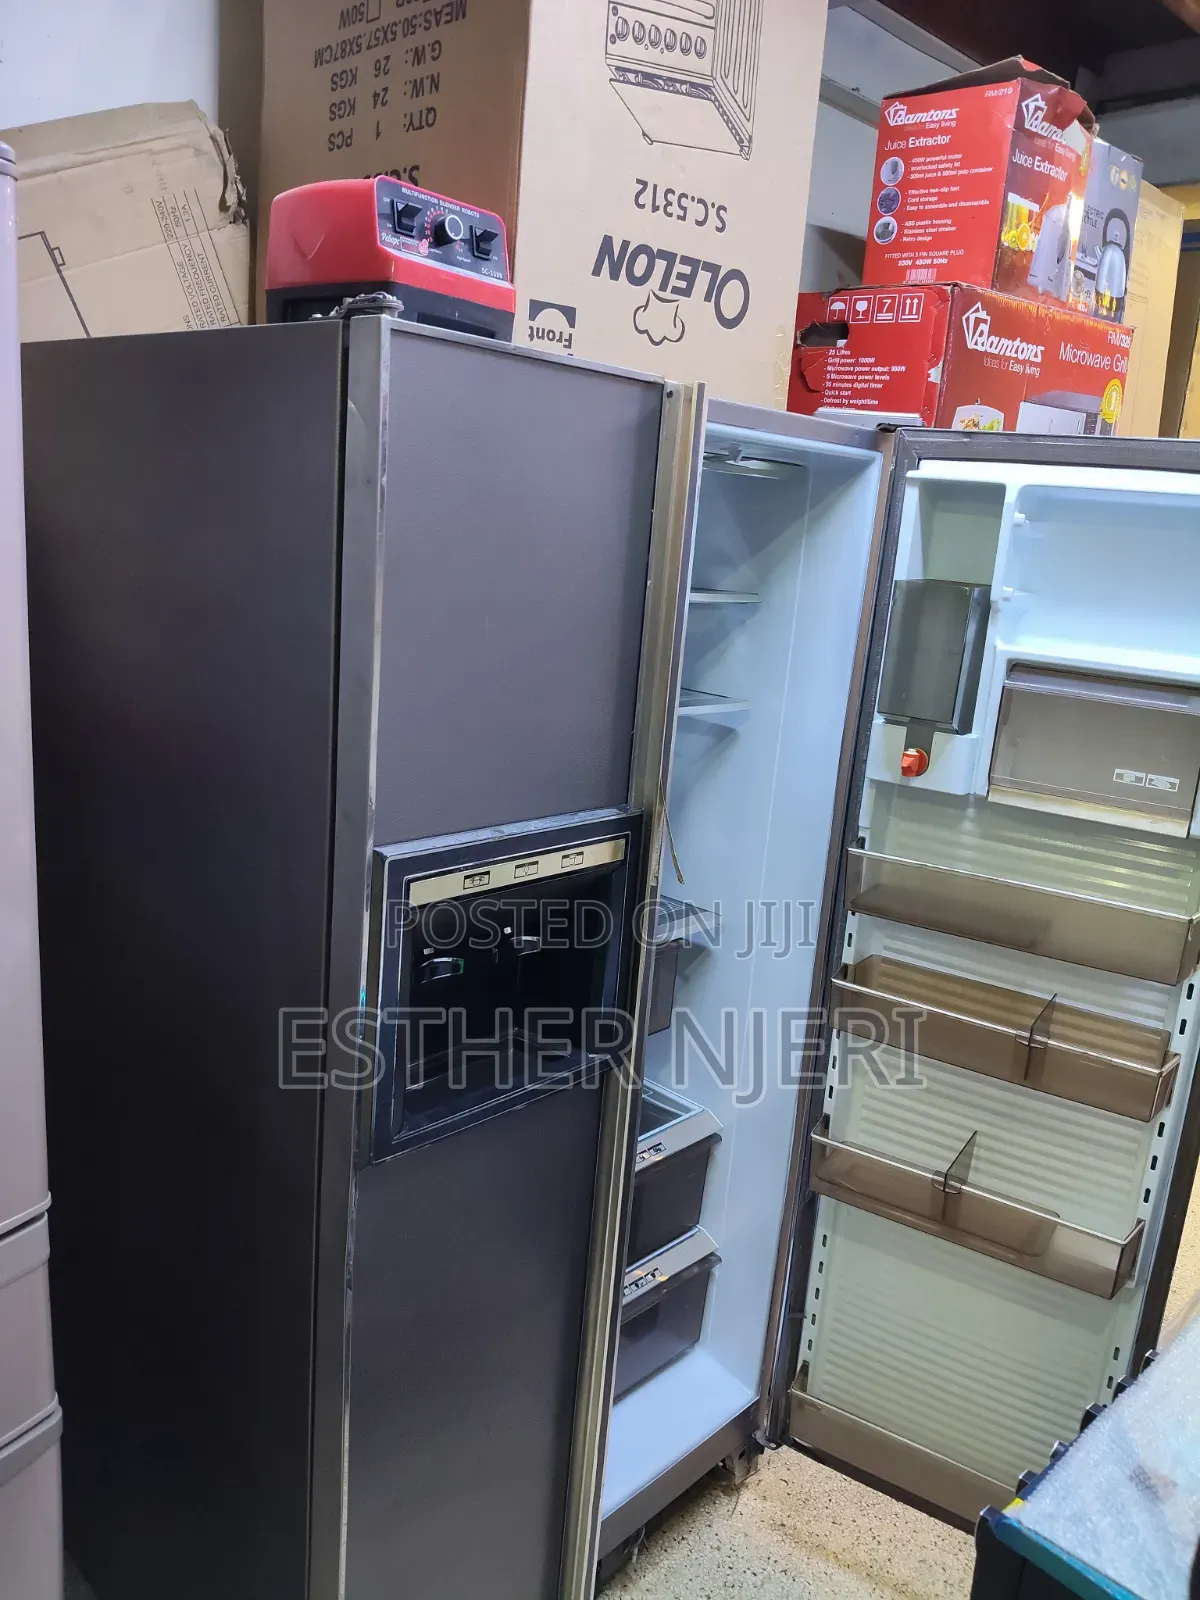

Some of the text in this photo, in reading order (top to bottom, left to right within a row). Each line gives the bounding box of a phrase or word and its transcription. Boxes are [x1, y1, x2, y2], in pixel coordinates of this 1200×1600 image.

[338, 2, 365, 30] 50W
[330, 65, 358, 92] KGS
[374, 55, 391, 78] 26
[329, 97, 356, 121] KGS
[372, 86, 389, 109] 24
[888, 105, 960, 126] Ramtons
[925, 122, 940, 130] Easy
[941, 121, 957, 129] living
[328, 106, 437, 151] QTY: 1 PCS
[885, 134, 952, 151] Juice Extractor
[925, 155, 947, 164] powerful
[1012, 149, 1068, 182] Juice Extractor
[401, 187, 439, 204] MULTIFUNCTION
[439, 200, 461, 212] BLENDER
[633, 178, 728, 233] S.C.5312
[920, 195, 938, 203] storage
[932, 218, 952, 226] housing
[916, 235, 933, 243] design
[884, 252, 902, 260] FITTED
[928, 249, 950, 257] SQUARE
[950, 248, 965, 256] PLUG
[176, 260, 196, 301] VOLTAGE
[182, 243, 205, 297] FREQUENCY
[591, 234, 750, 330] OLELON
[196, 252, 226, 323] RATED CURRENT
[192, 301, 205, 329] RATED
[201, 297, 215, 326] RATED
[882, 299, 892, 313] 7
[528, 325, 573, 349] Front
[969, 318, 1045, 364] Ramtons
[983, 356, 1000, 369] Ideas
[1008, 360, 1025, 375] Easy
[1025, 362, 1041, 378] living
[1059, 341, 1112, 370] Microwave
[830, 373, 857, 381] Microwave
[853, 382, 870, 390] digital
